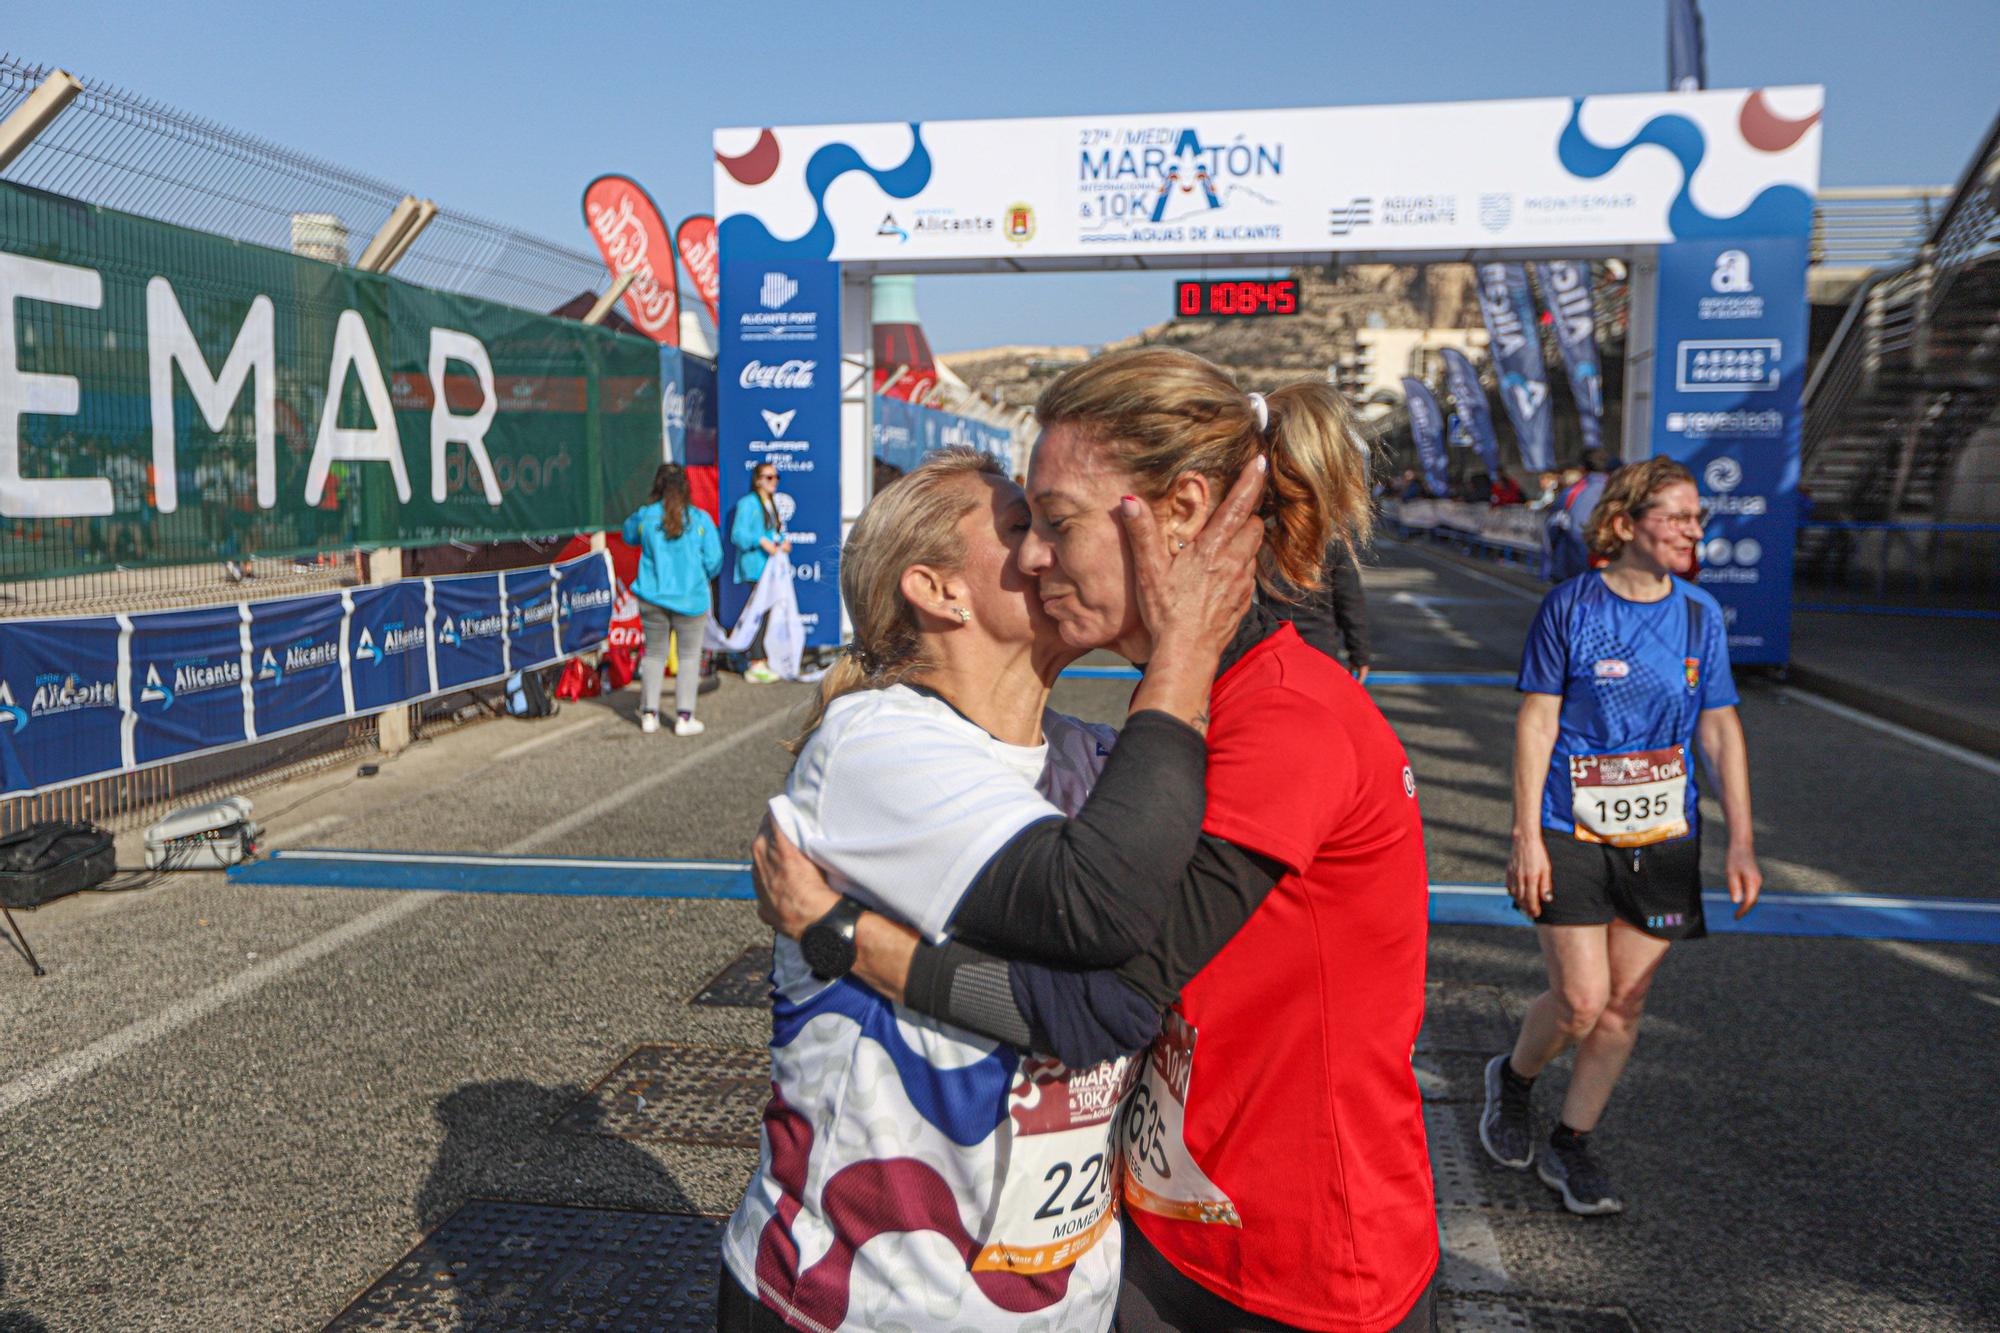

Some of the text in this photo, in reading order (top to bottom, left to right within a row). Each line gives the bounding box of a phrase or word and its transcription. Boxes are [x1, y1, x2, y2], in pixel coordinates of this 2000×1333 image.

[1098, 194, 1148, 216] 10K
[285, 640, 338, 671] Alicante
[174, 660, 241, 692] Alicante
[1651, 759, 1682, 781] 10K
[1595, 793, 1668, 823] 1935
[1077, 1089, 1102, 1108] 10K
